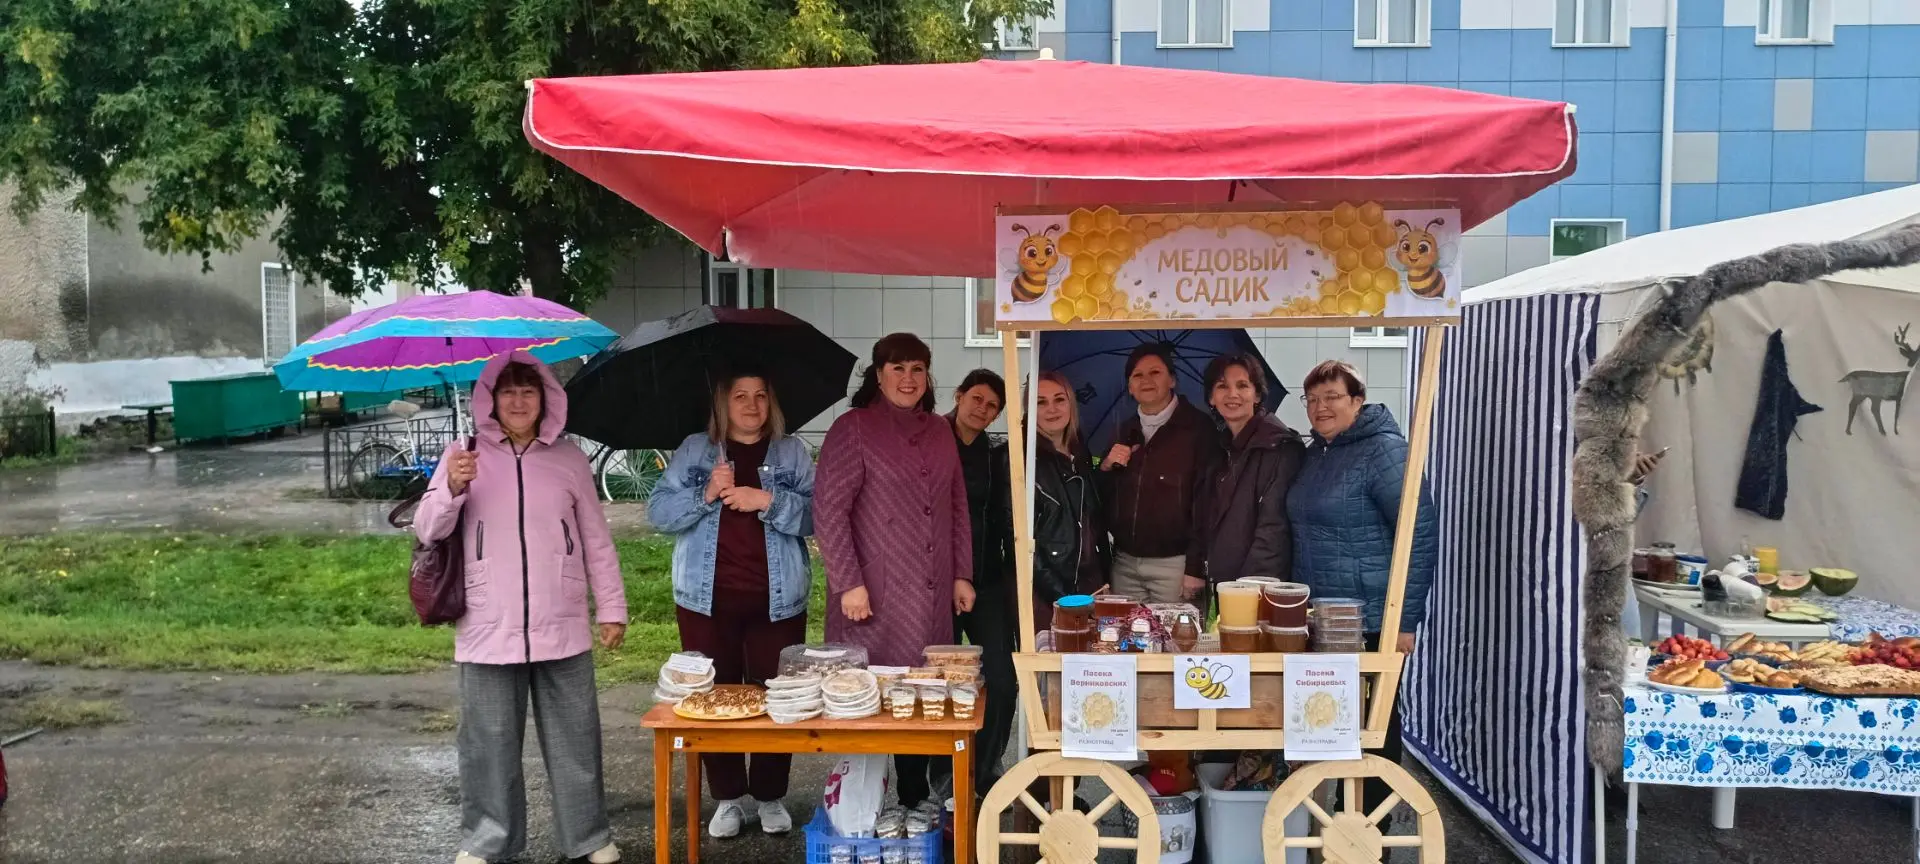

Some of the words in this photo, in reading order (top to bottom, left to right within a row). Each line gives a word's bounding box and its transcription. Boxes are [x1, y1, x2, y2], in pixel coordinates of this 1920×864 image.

[1158, 240, 1288, 276] МЕДОВЫЙ
[1175, 276, 1270, 307] САДИК
[1083, 669, 1113, 677] Пасека
[1305, 669, 1335, 677] Пасека
